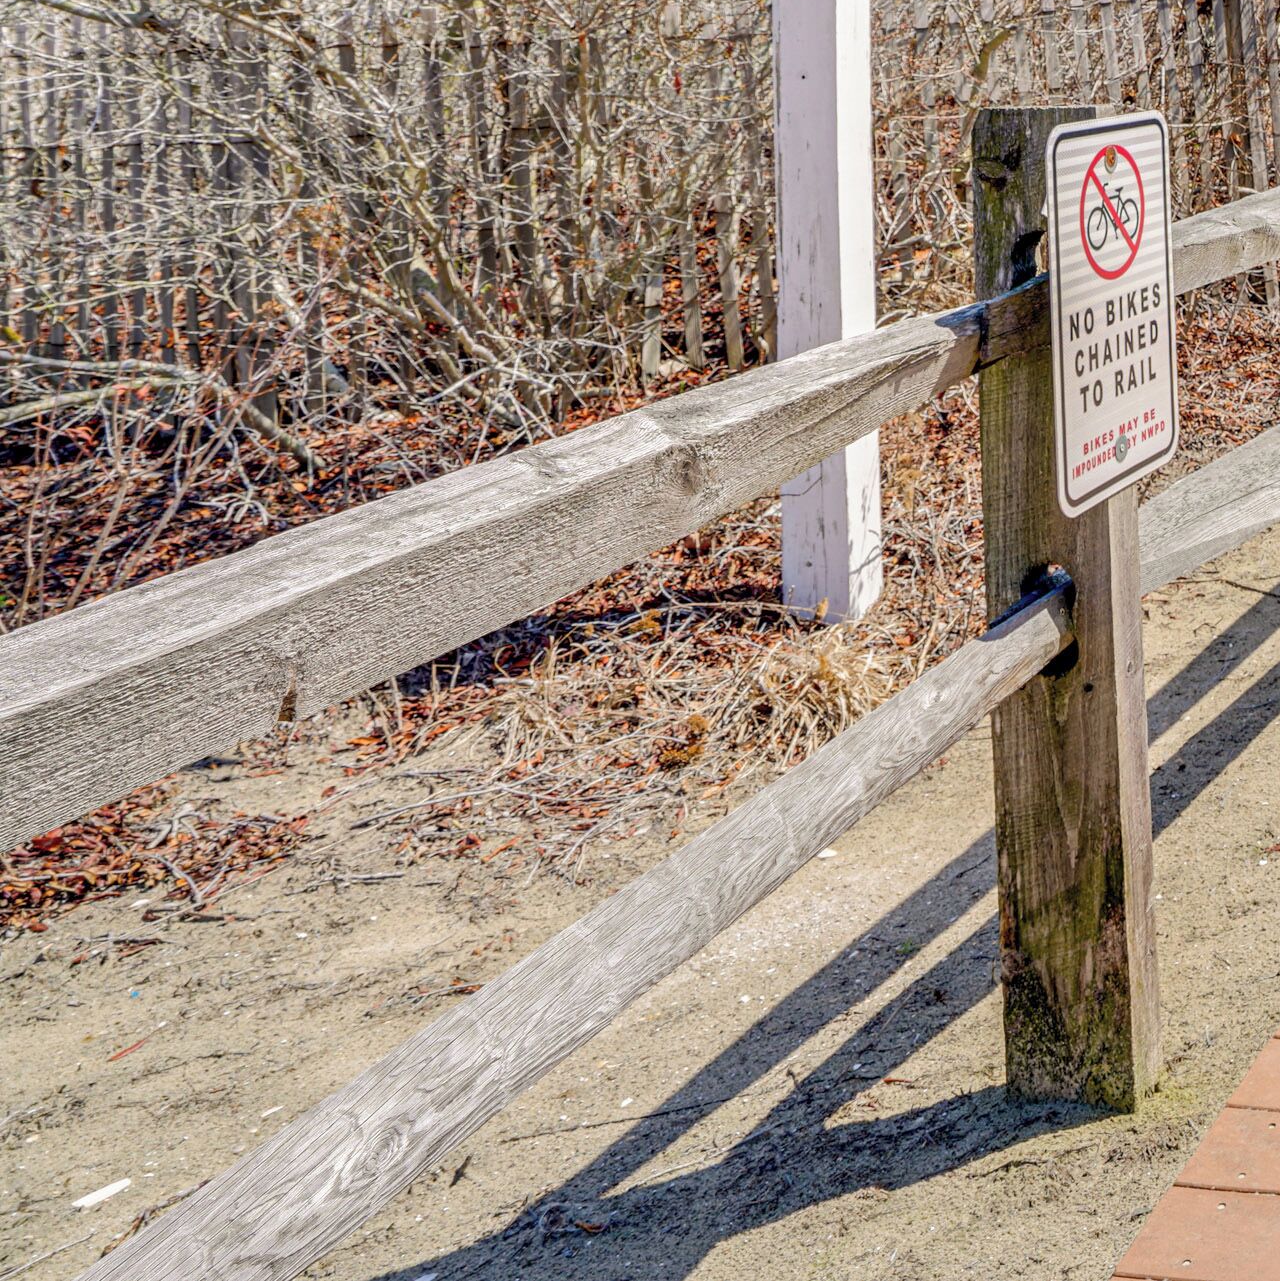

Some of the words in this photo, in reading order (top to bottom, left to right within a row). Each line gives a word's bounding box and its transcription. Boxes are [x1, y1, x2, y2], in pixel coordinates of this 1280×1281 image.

[1069, 307, 1094, 342] NO
[1106, 283, 1161, 327] BIKES
[1075, 320, 1158, 377] CHAINED
[1080, 380, 1103, 413] TO
[1115, 356, 1156, 397] RAIL
[1072, 445, 1117, 480] IMPOUNDED
[1127, 434, 1137, 449] BY
[1141, 420, 1165, 442] NWPD
[1083, 430, 1114, 455] BIKES
[1119, 416, 1139, 436] MAY
[1143, 408, 1156, 424] BE
